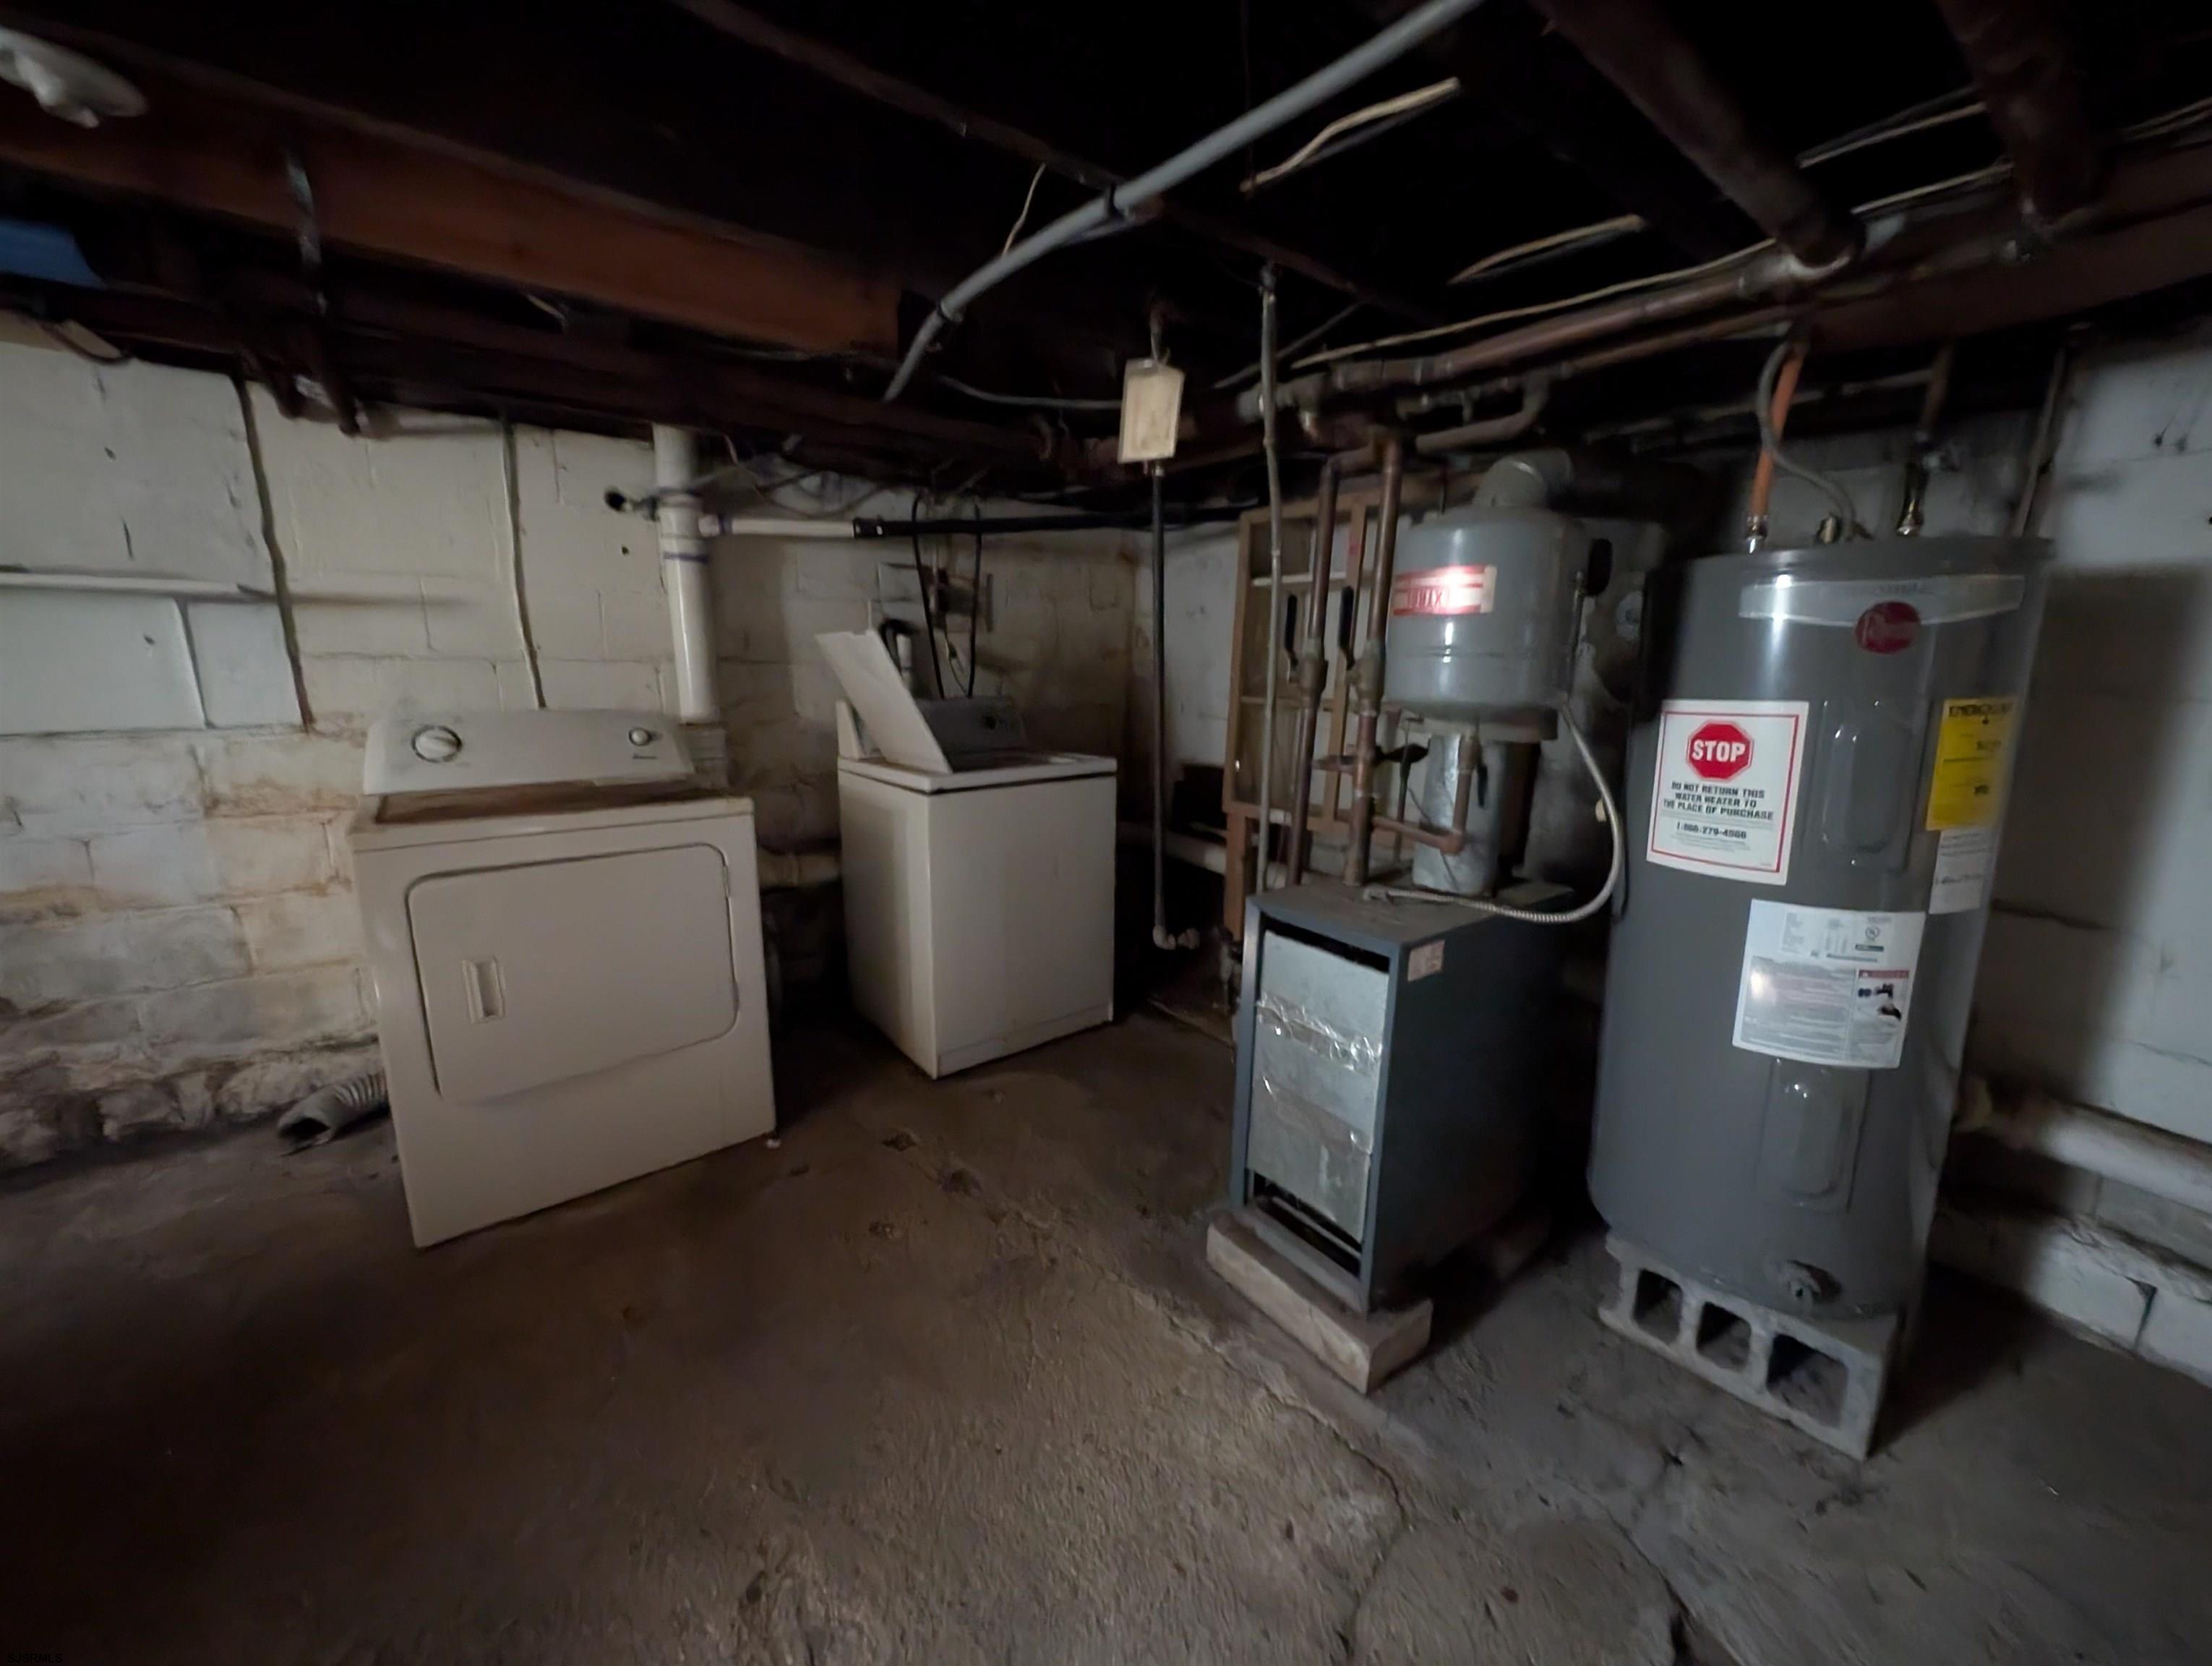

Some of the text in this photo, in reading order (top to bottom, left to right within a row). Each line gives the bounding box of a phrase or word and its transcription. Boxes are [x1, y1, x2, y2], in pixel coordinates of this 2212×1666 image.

[1692, 740, 1746, 763] STOP
[1671, 781, 1765, 798] DO NOT RETURN THIS
[1663, 798, 1675, 809] THE
[1677, 802, 1702, 813] PLACE
[1706, 806, 1718, 814] OF
[1720, 808, 1774, 820] PURCHASE
[1675, 793, 1702, 803] WATER
[1705, 796, 1741, 806] HEATER
